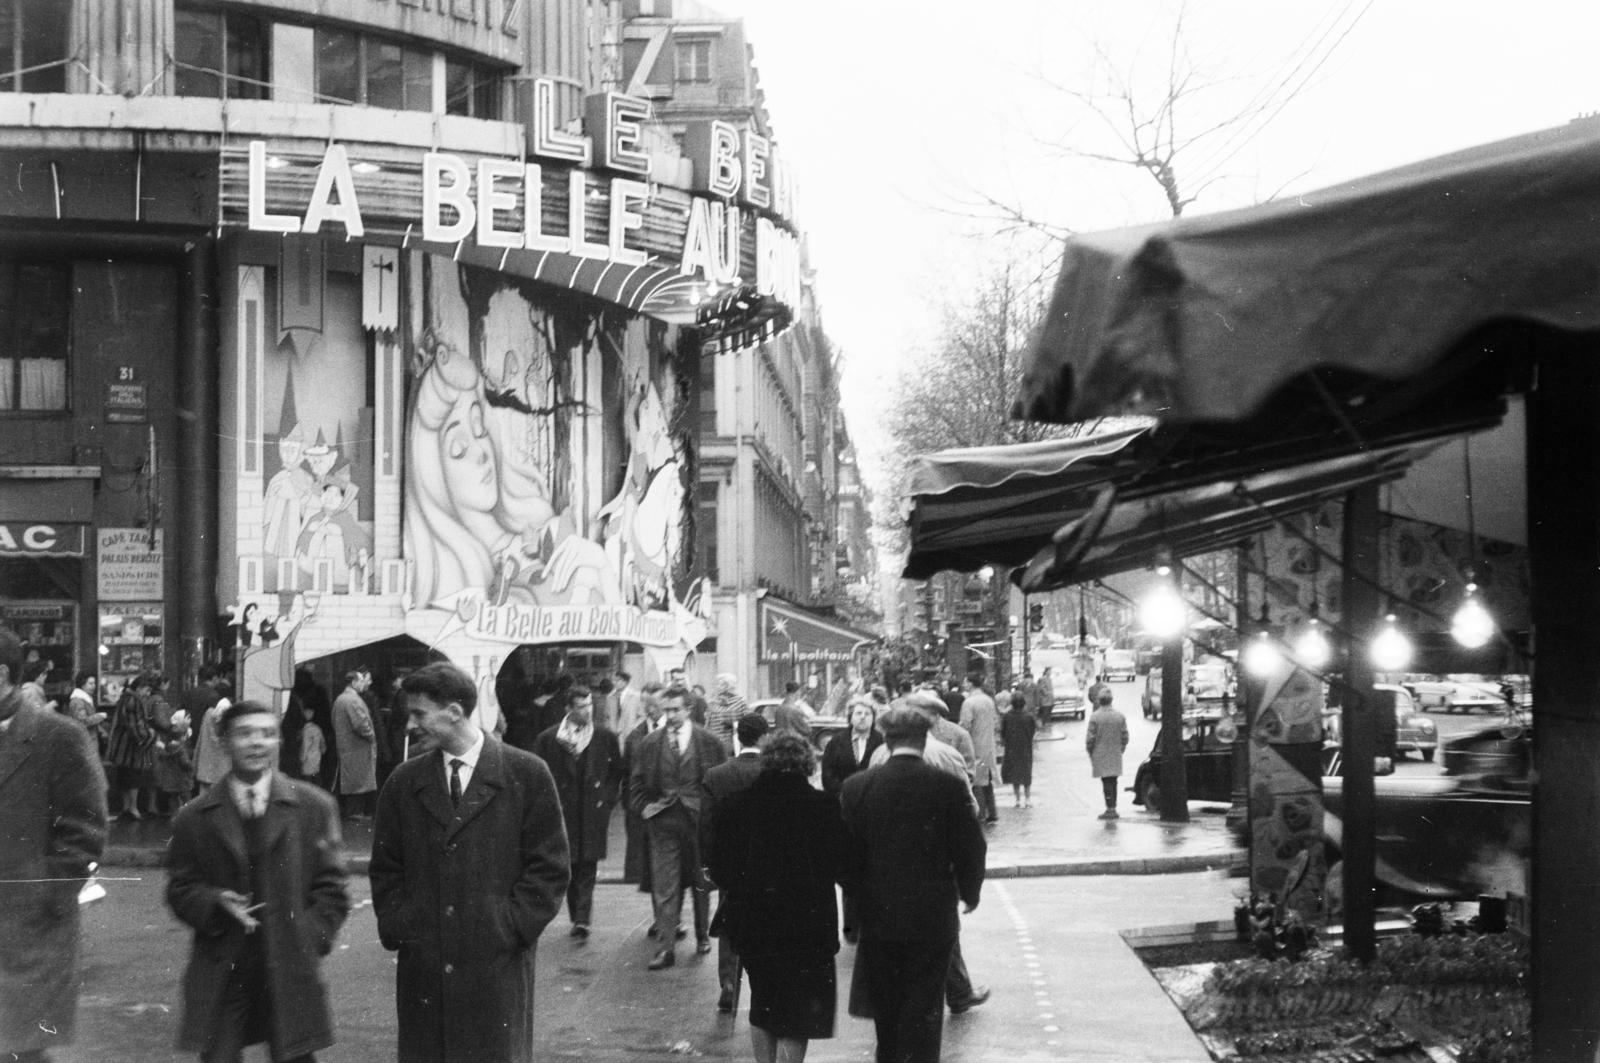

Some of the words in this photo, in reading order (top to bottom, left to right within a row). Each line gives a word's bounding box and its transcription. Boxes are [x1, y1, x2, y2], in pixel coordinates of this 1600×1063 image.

[533, 77, 652, 175] LE
[248, 140, 365, 237] LA
[422, 152, 651, 266] BELLE
[680, 196, 742, 284] AU
[119, 366, 134, 381] 31
[476, 602, 498, 636] La
[504, 604, 553, 639] Belle
[558, 610, 583, 636] au
